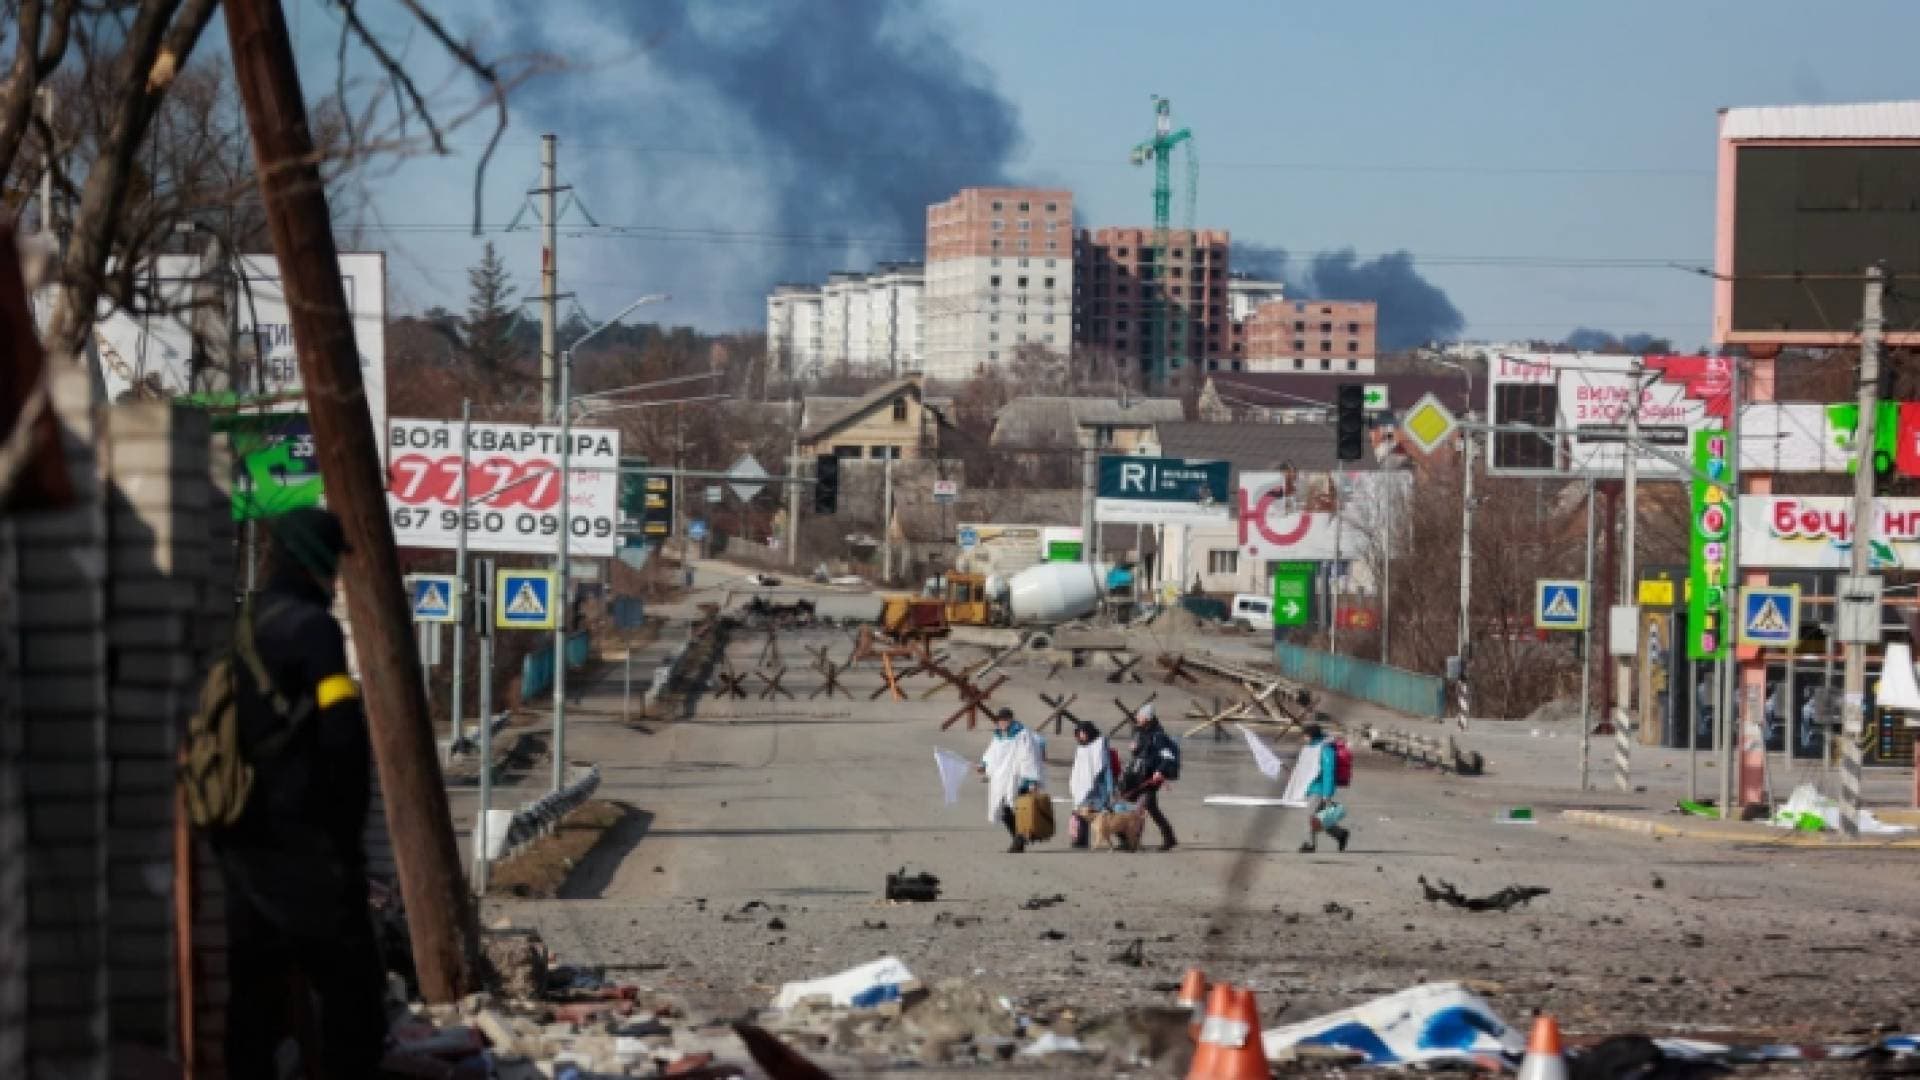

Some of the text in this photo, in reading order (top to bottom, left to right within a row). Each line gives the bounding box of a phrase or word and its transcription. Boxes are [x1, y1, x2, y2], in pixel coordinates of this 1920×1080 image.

[466, 429, 614, 457] КВАРТИРА
[400, 462, 555, 503] 7777
[1120, 463, 1146, 492] R
[440, 510, 505, 533] 960
[515, 514, 559, 536] 09
[571, 516, 612, 538] 09
